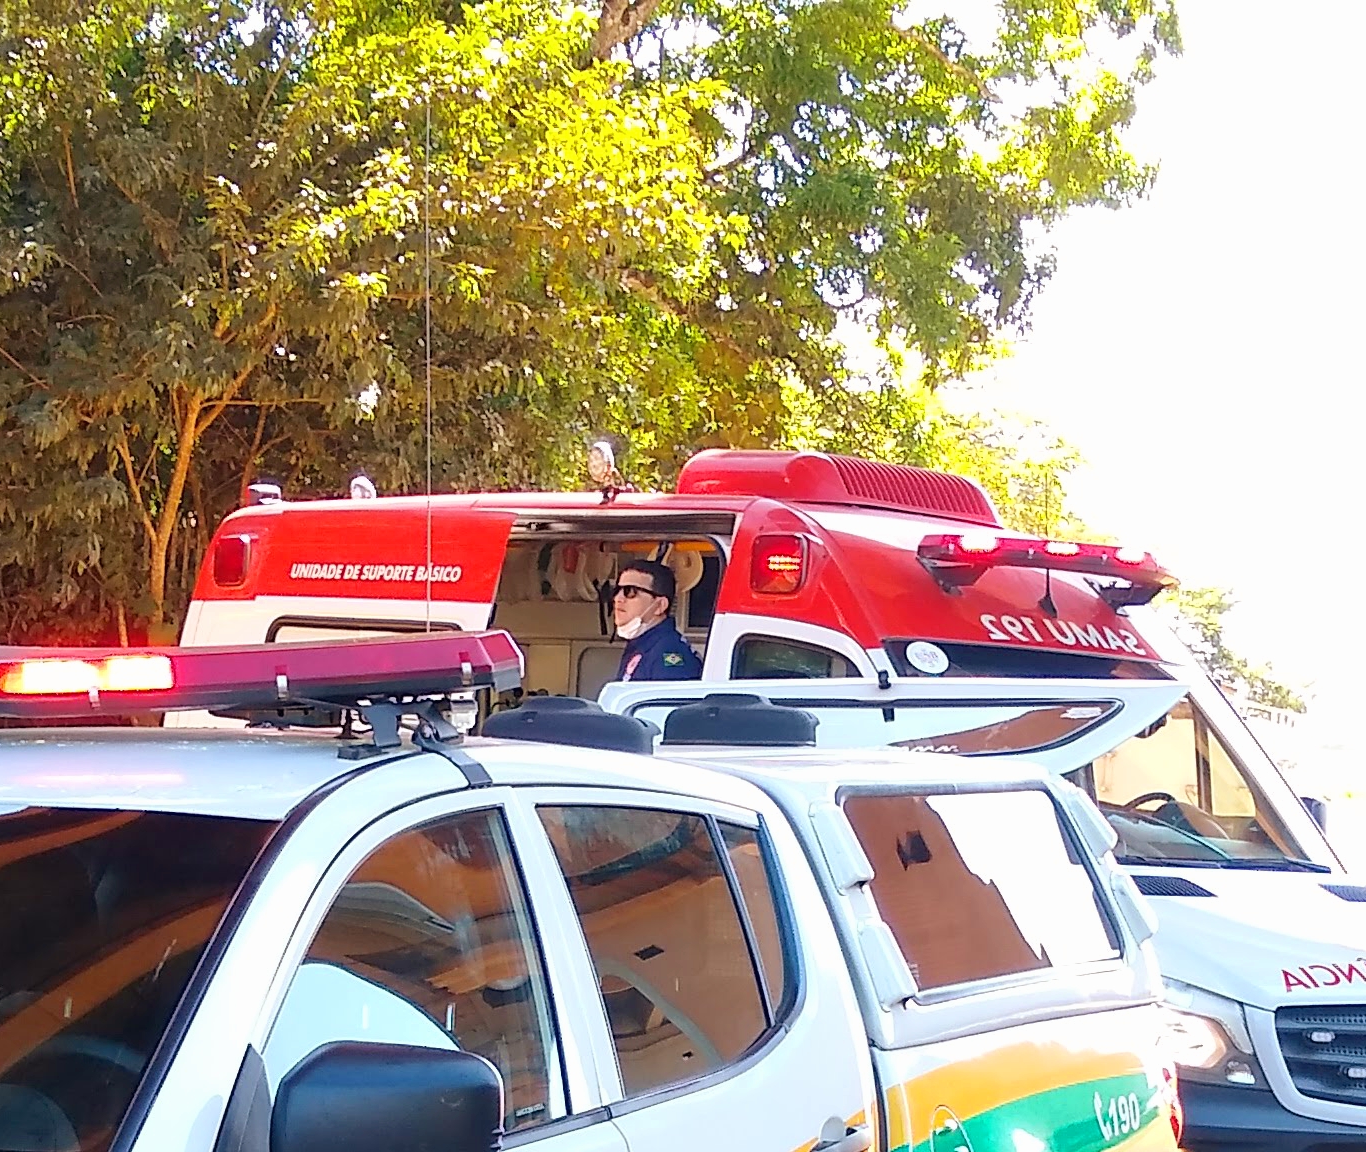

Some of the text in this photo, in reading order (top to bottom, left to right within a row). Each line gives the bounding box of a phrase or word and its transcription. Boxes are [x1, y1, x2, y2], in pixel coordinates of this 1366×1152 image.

[290, 562, 462, 583] UNIDADE DE SUPORTE BÁSICO
[1108, 1092, 1140, 1137] 190
